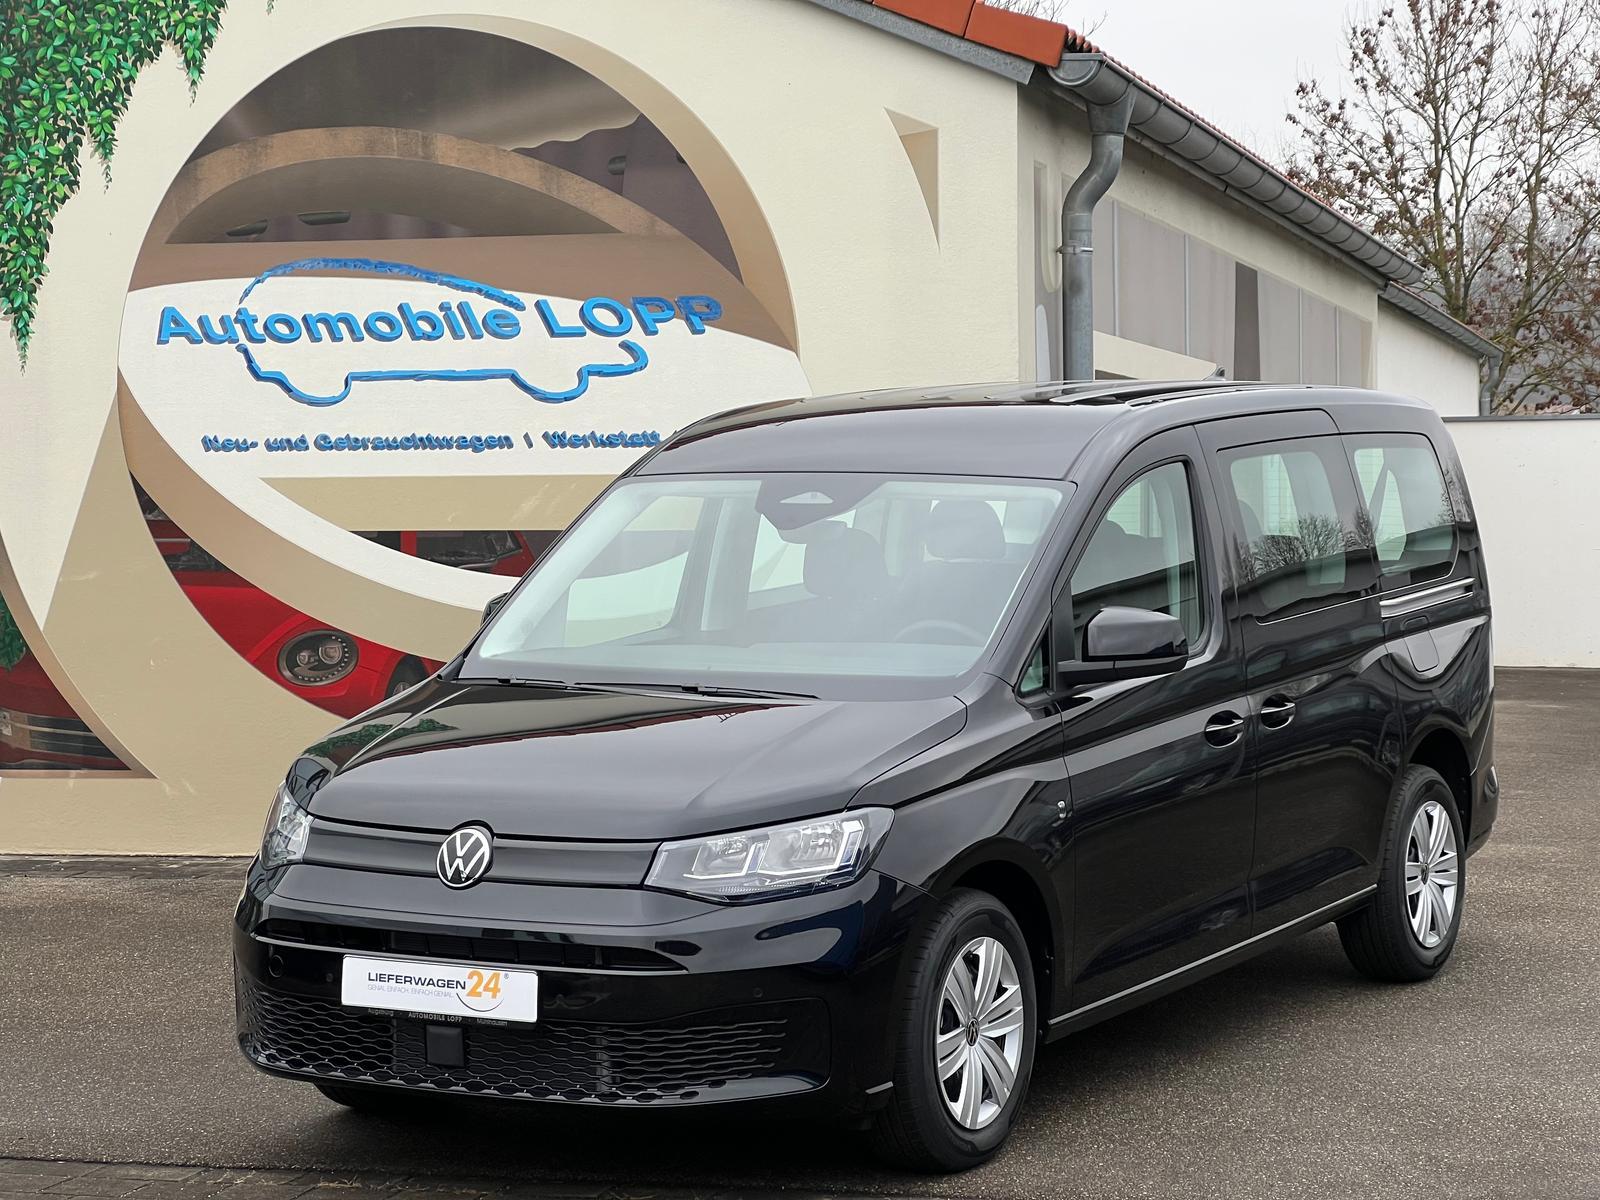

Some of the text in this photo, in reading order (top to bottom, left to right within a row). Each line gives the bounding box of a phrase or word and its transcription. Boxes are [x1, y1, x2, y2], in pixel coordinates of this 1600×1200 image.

[157, 295, 722, 345] Automobile LOPP
[200, 434, 259, 452] Neu-
[264, 434, 310, 452] und
[313, 432, 514, 453] Gebrauchtwagen
[542, 430, 661, 449] Werkstatt
[367, 969, 502, 1000] LIEFERWAGEN 24
[408, 1011, 446, 1021] AUTOMOBILE
